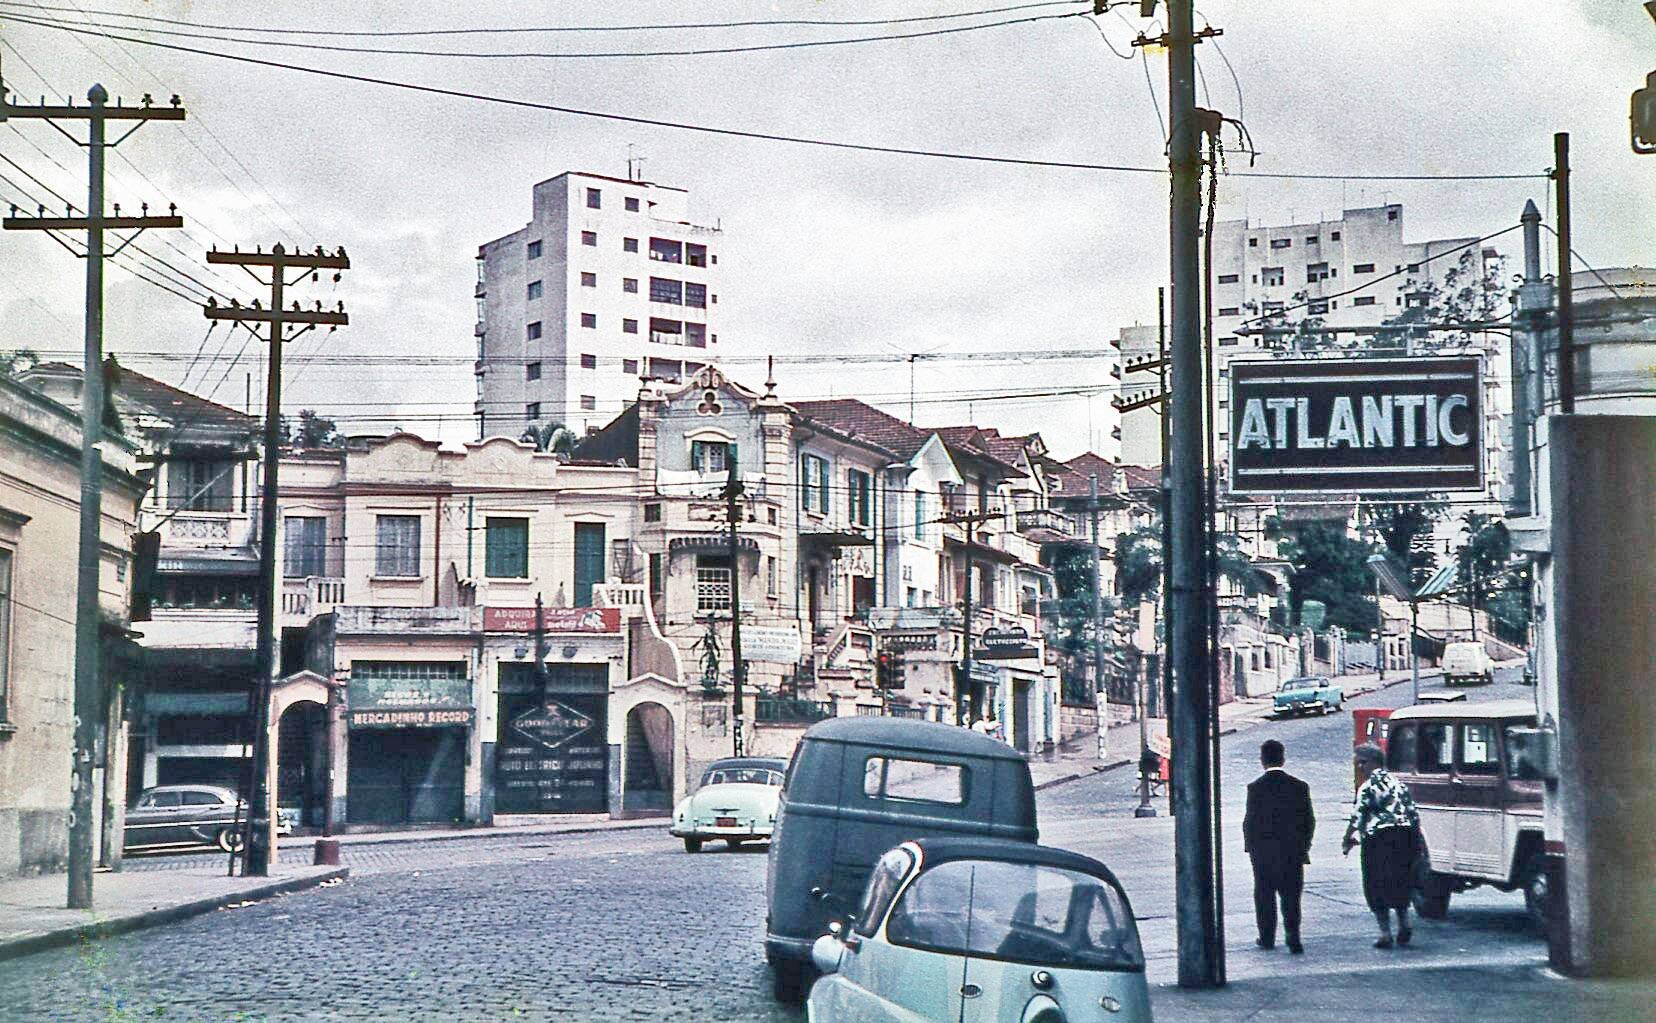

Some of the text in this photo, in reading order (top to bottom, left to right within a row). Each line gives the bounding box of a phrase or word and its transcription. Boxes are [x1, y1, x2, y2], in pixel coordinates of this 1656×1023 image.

[1237, 393, 1471, 449] ATLANTIC
[354, 711, 470, 725] MERCADINHO RECORD
